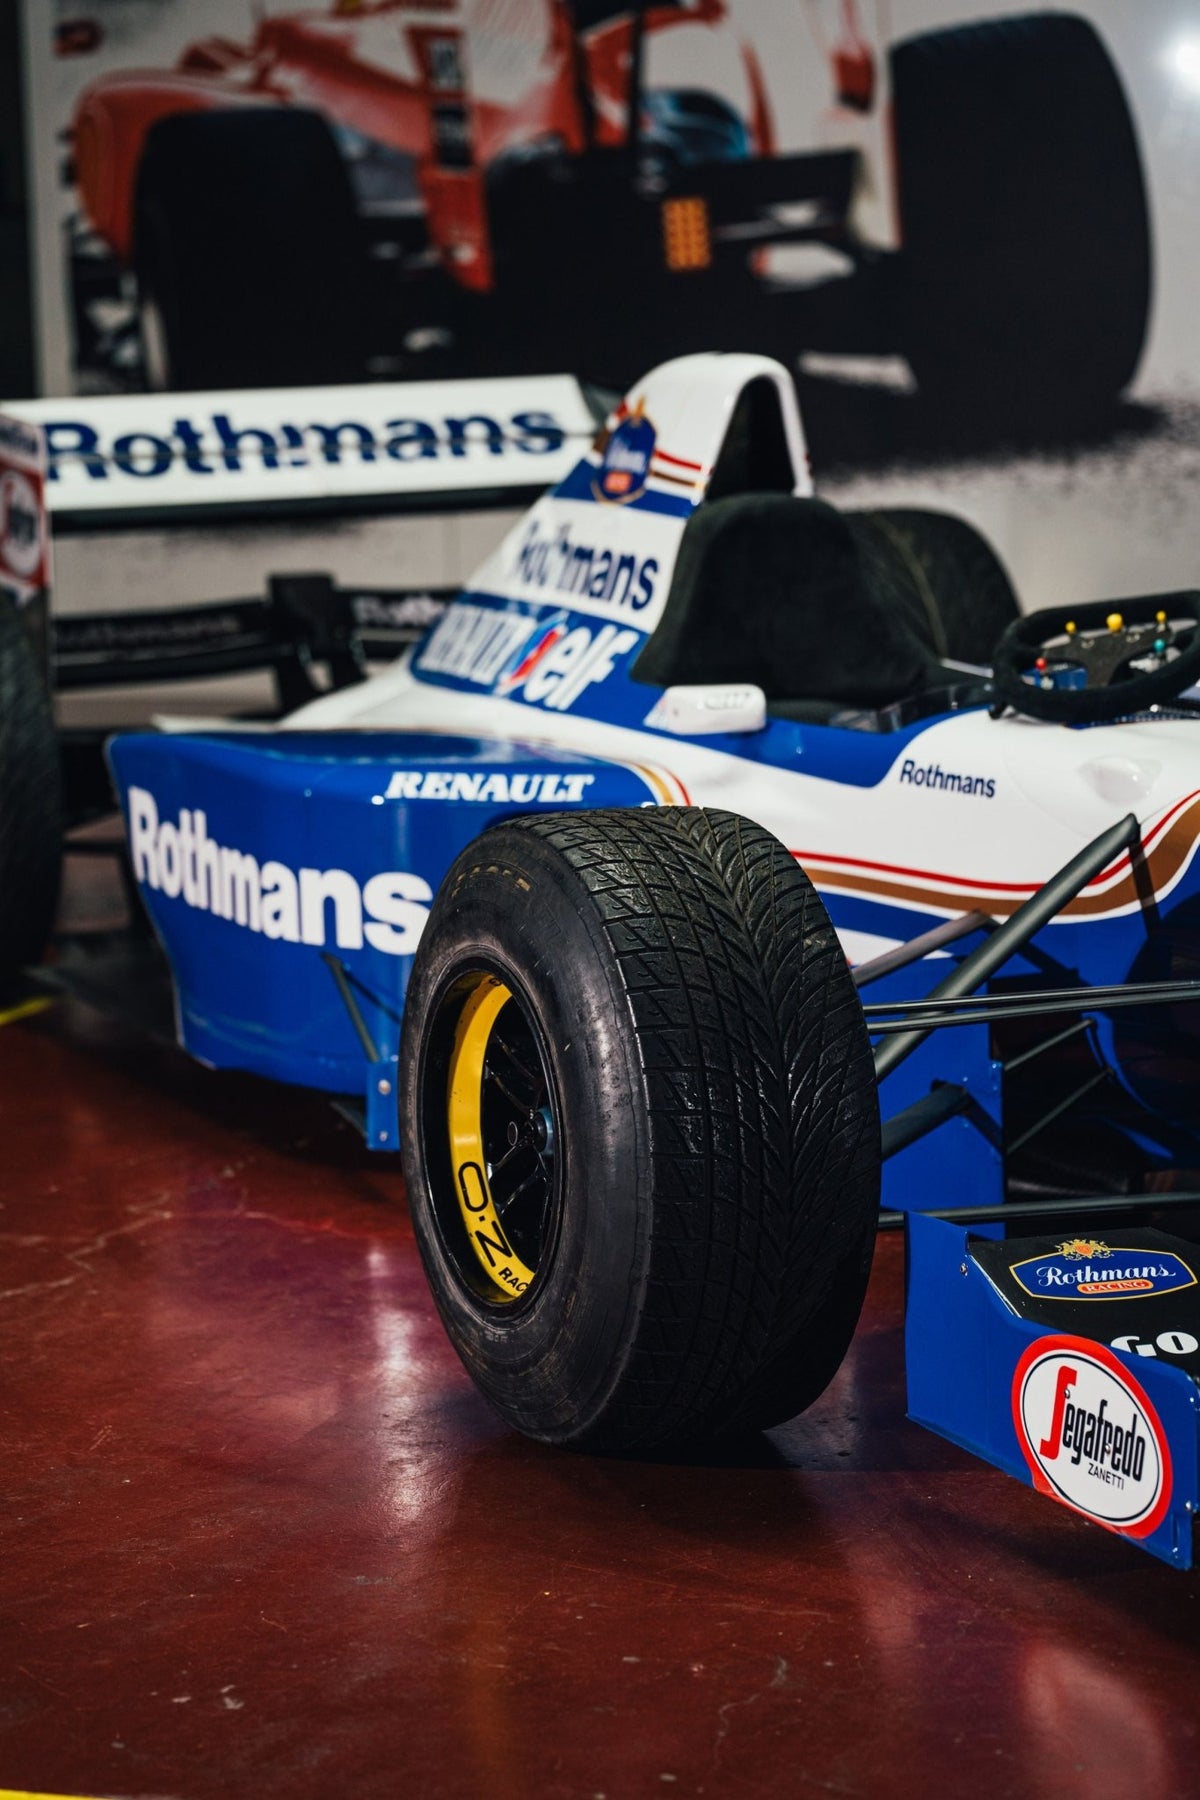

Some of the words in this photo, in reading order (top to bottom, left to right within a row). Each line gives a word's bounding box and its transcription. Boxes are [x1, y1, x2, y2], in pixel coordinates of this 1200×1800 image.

[44, 408, 565, 482] Rothmans
[523, 624, 639, 711] elf
[385, 771, 594, 804] RENAULT
[900, 760, 996, 798] Rothmans
[127, 786, 435, 957] Rothmans
[1037, 1265, 1176, 1287] Rothmans
[1086, 1281, 1146, 1292] RACING
[1039, 1365, 1147, 1483] Segafredo
[1088, 1462, 1125, 1491] ZANETTI
